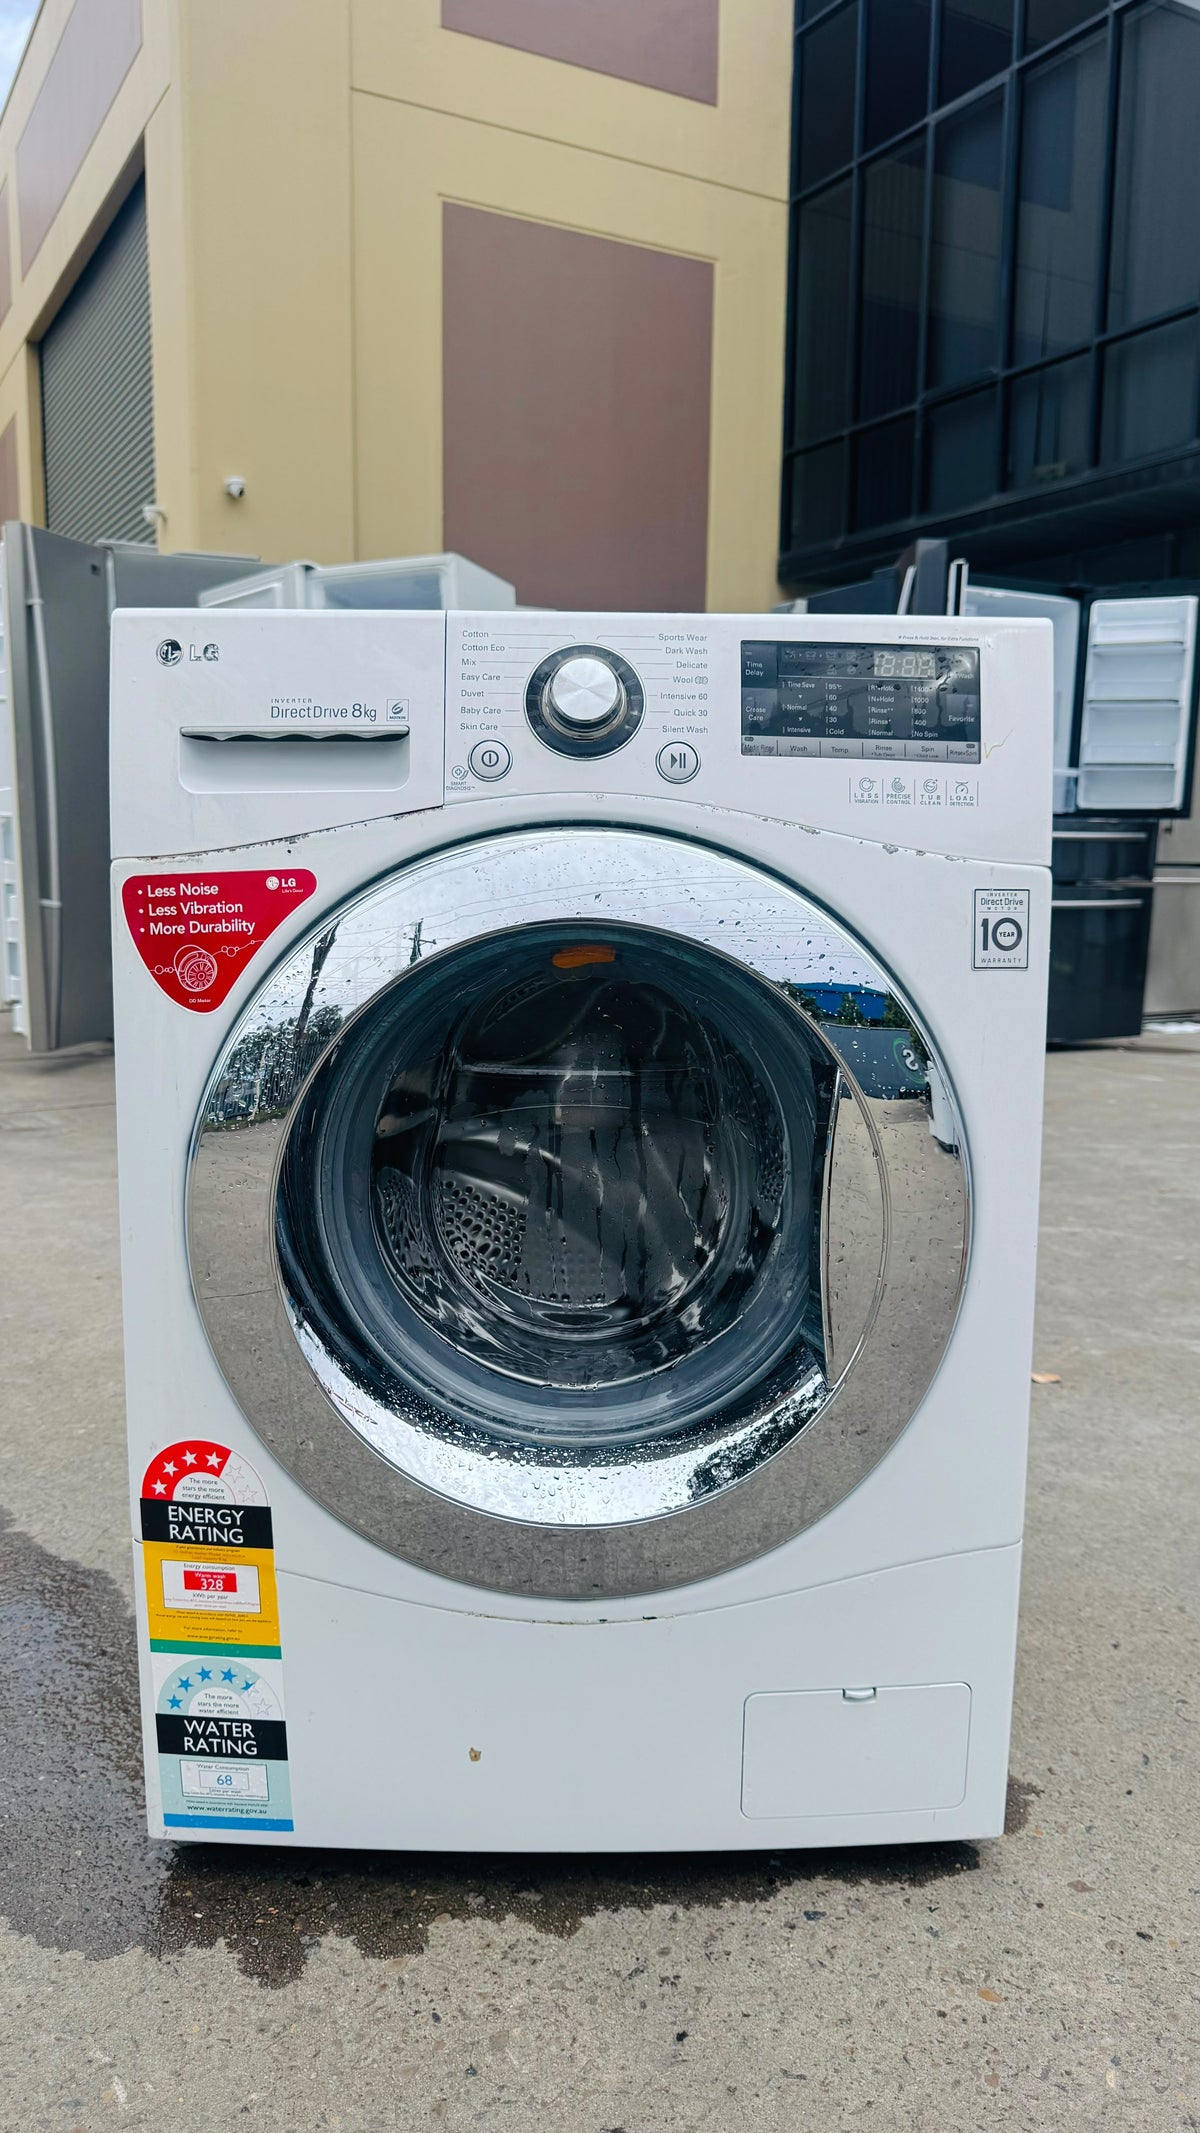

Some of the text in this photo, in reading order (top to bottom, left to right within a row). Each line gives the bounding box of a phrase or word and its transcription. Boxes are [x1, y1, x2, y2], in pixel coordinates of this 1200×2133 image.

[658, 634, 684, 642] Sports
[190, 644, 220, 661] LG
[676, 661, 708, 669] Delicate
[746, 669, 763, 677] Delay
[660, 692, 696, 700] Intensive
[352, 704, 376, 722] 8kg
[674, 709, 708, 717] Quick 30
[686, 726, 708, 734] Wash
[282, 878, 296, 887] LG
[148, 882, 218, 897] Less Noise
[148, 901, 243, 916] Less Vibration
[150, 918, 255, 935] More Durability
[981, 917, 1022, 951] 10
[168, 1506, 244, 1525] ENERGY
[169, 1524, 244, 1544] RATING
[201, 1579, 223, 1591] 328
[184, 1719, 255, 1738] WATER
[184, 1737, 257, 1755] RATING
[217, 1775, 232, 1786] 68
[187, 1805, 267, 1814] www.waterrating.gov.au
